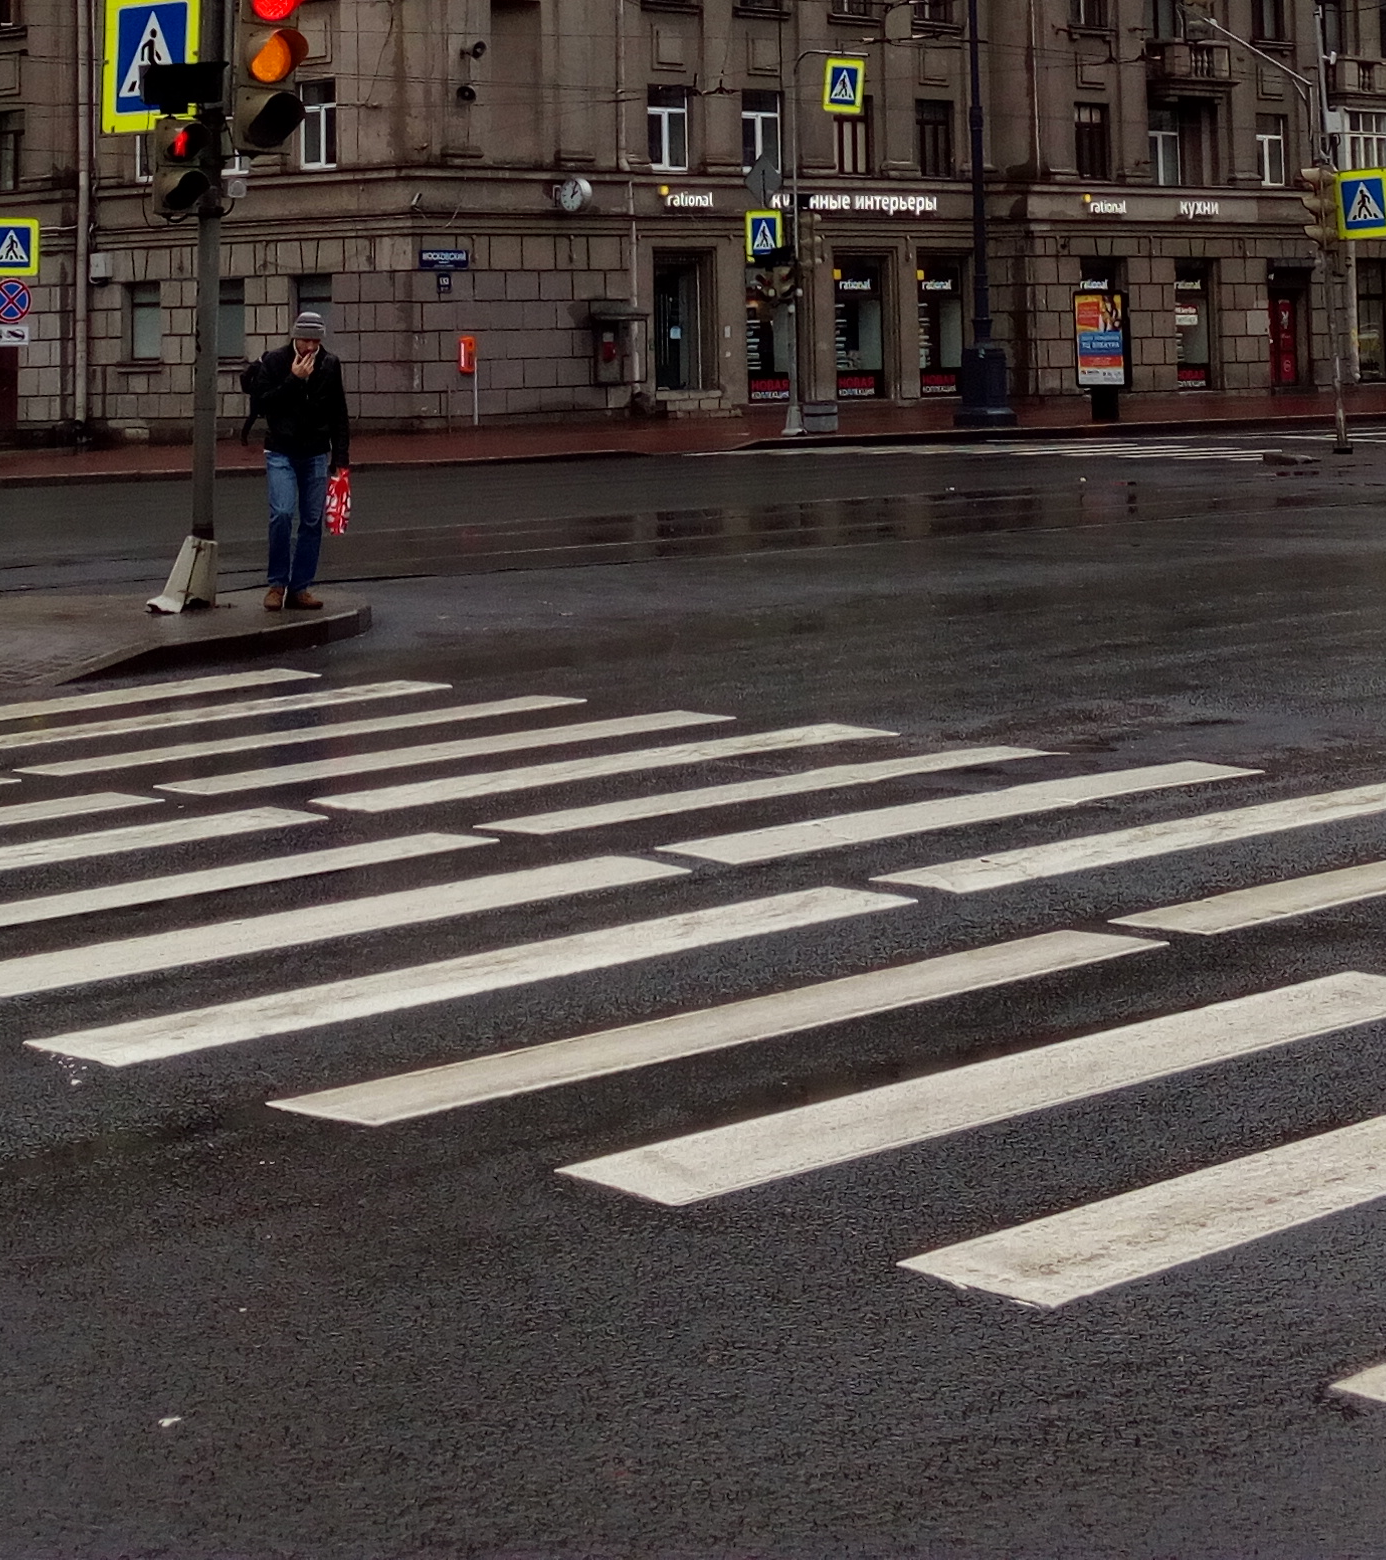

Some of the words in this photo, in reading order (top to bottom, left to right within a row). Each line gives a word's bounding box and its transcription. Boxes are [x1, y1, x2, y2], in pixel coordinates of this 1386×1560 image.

[666, 191, 713, 207] rational
[771, 192, 851, 211] кунные
[854, 194, 938, 215] интерьеры
[1089, 200, 1127, 215] rational
[839, 278, 872, 290] rational
[921, 278, 953, 290] rational
[751, 379, 789, 391] НОВАЯ
